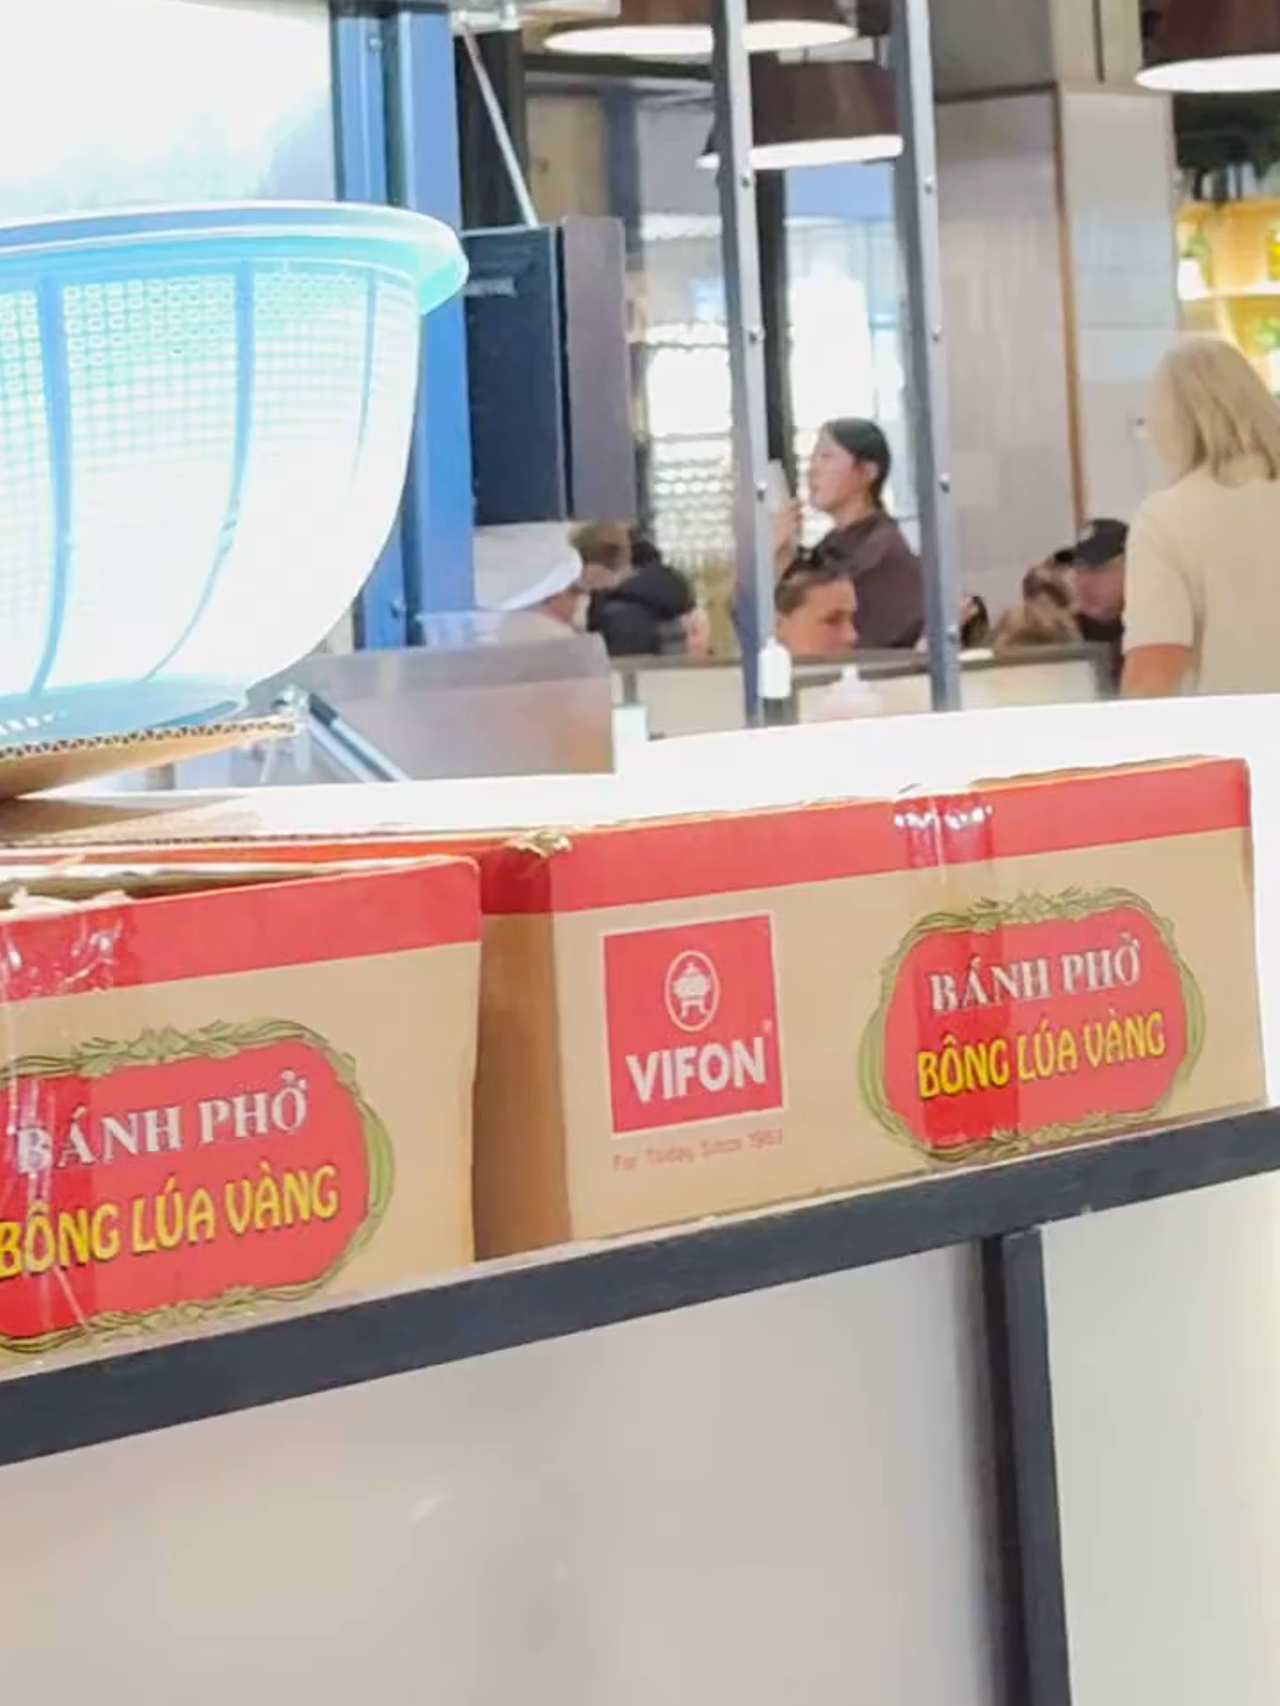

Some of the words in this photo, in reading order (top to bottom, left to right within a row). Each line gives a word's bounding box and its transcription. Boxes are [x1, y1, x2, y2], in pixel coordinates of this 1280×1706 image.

[928, 954, 1052, 1014] BÁNH
[1060, 931, 1141, 994] PHỞ
[625, 1035, 767, 1105] VIFON
[917, 1033, 1010, 1099] BÔNG
[1016, 1016, 1079, 1081] LÚA
[1083, 1007, 1166, 1069] VÀNG
[16, 1105, 184, 1175] BÁNH
[197, 1069, 308, 1144] PHỞ
[130, 1171, 217, 1255] LÚA
[224, 1159, 339, 1236] VÀNG
